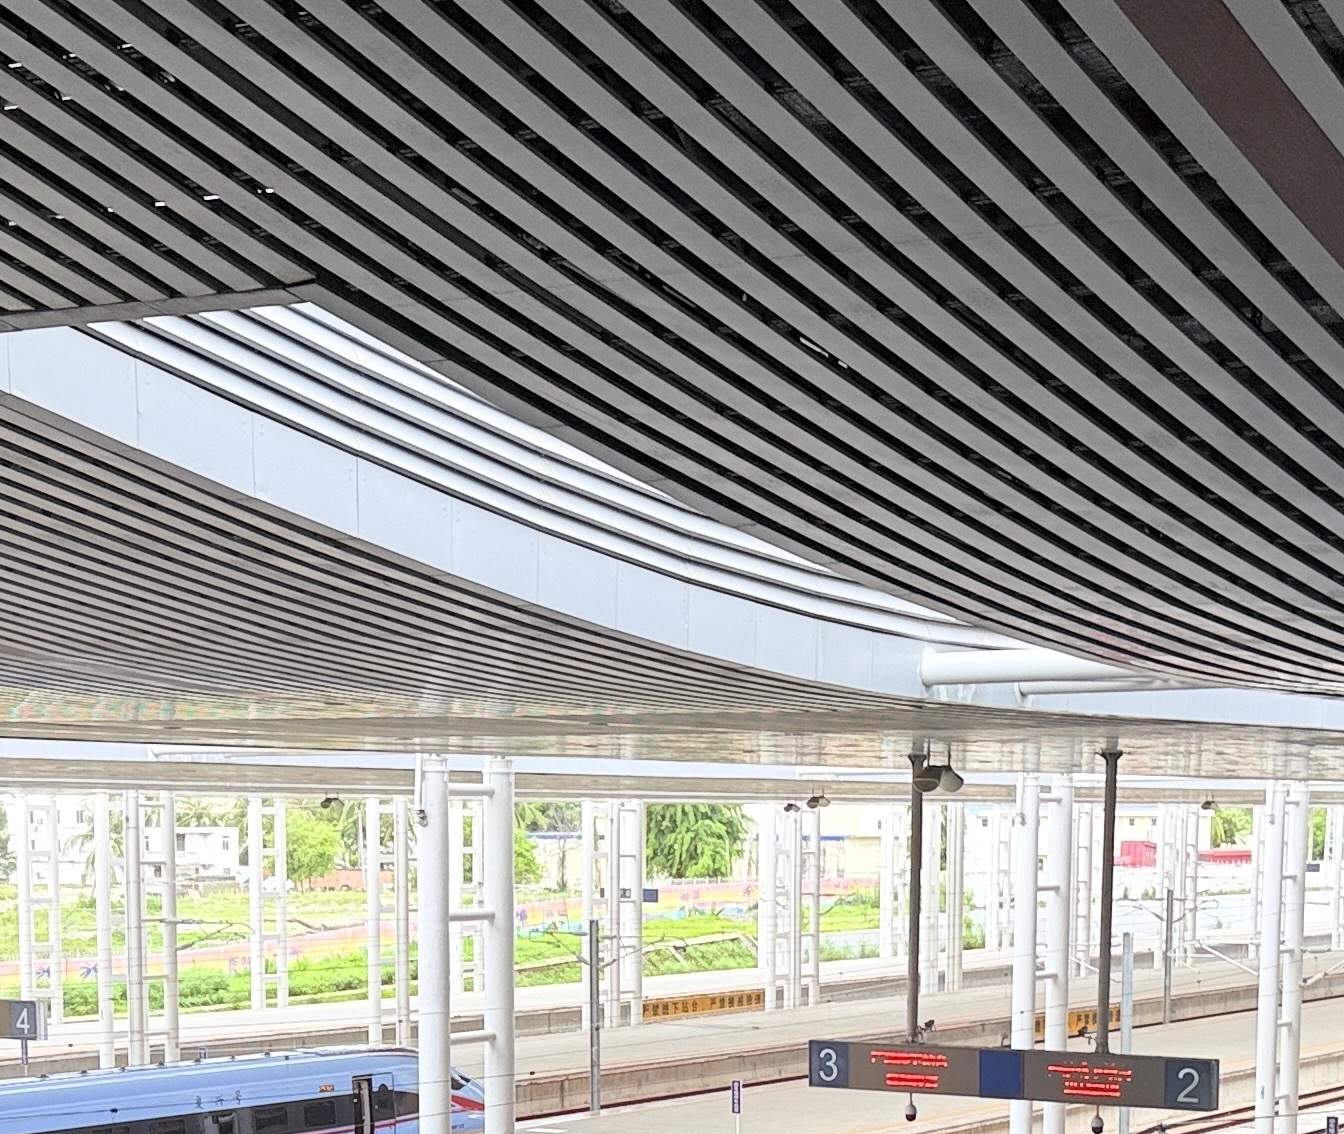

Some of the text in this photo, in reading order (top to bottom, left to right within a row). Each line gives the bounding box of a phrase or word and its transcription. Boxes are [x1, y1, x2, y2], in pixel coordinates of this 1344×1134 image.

[15, 1006, 31, 1035] 4
[817, 1048, 839, 1082] 3
[1176, 1067, 1200, 1103] 2
